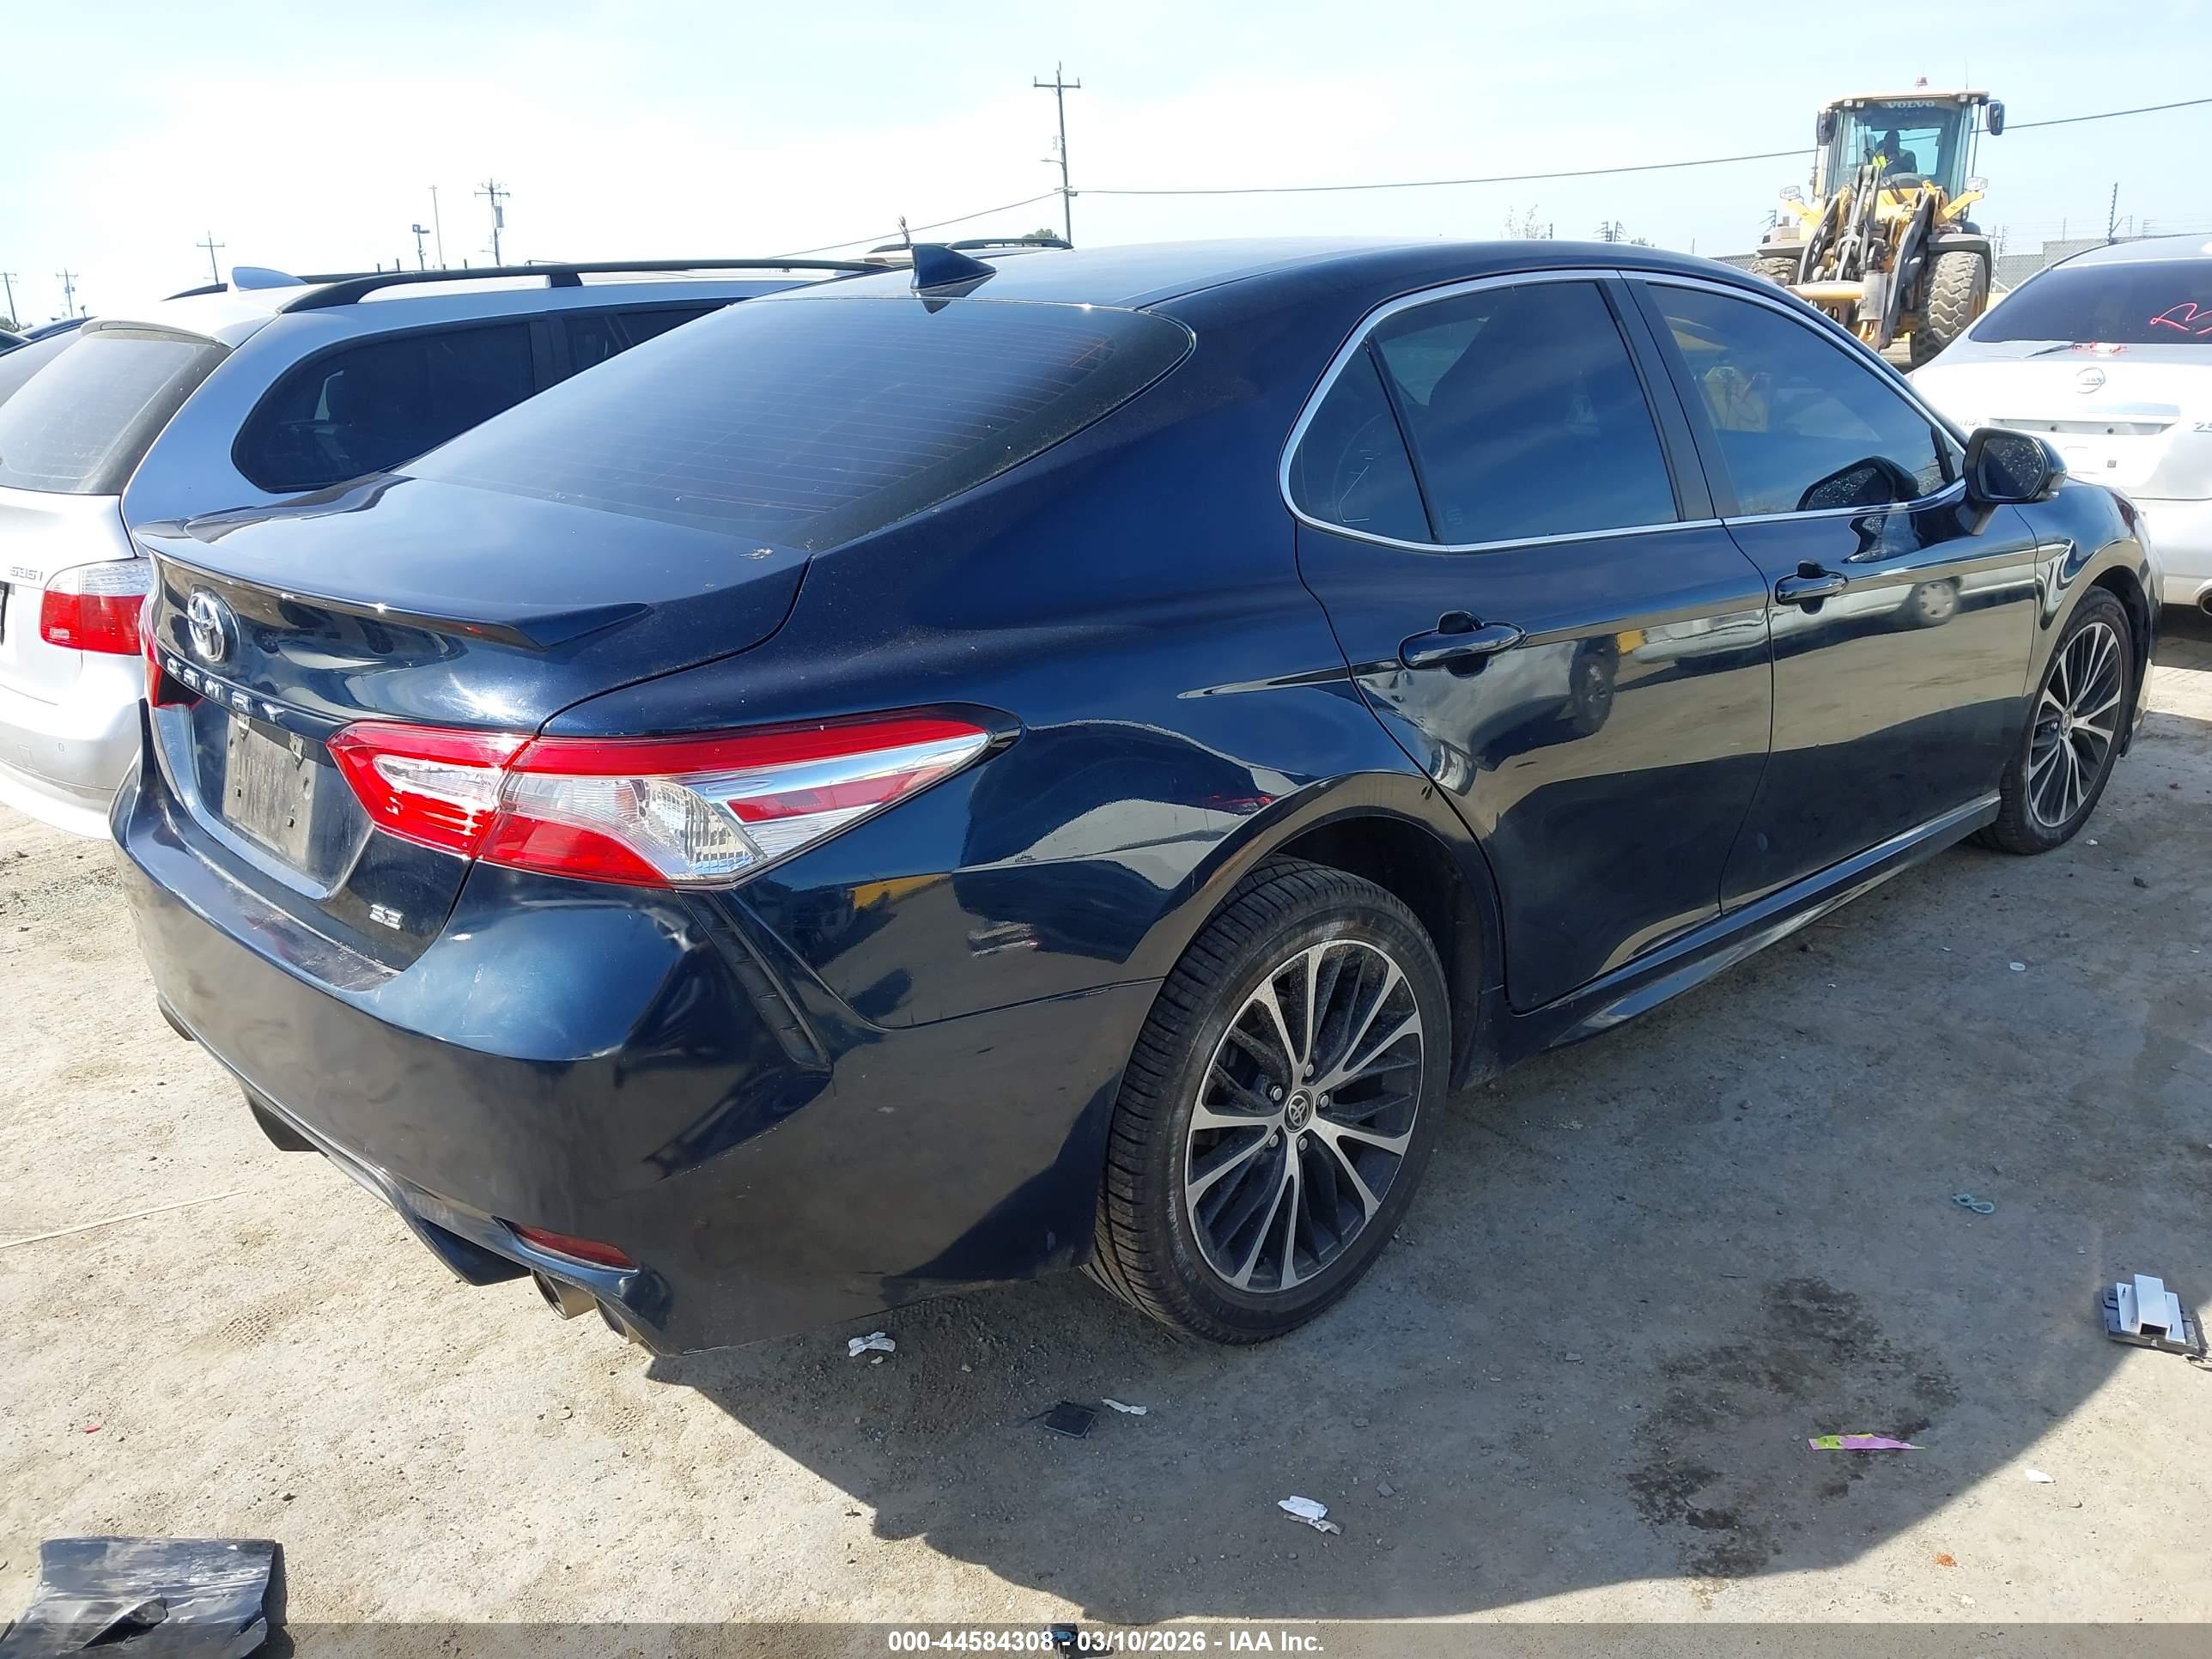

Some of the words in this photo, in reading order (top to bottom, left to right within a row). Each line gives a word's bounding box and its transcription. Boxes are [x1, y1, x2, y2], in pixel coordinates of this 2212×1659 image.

[1887, 100, 1936, 109] VOLVO
[167, 658, 285, 723] CAMRY
[369, 903, 403, 931] SE
